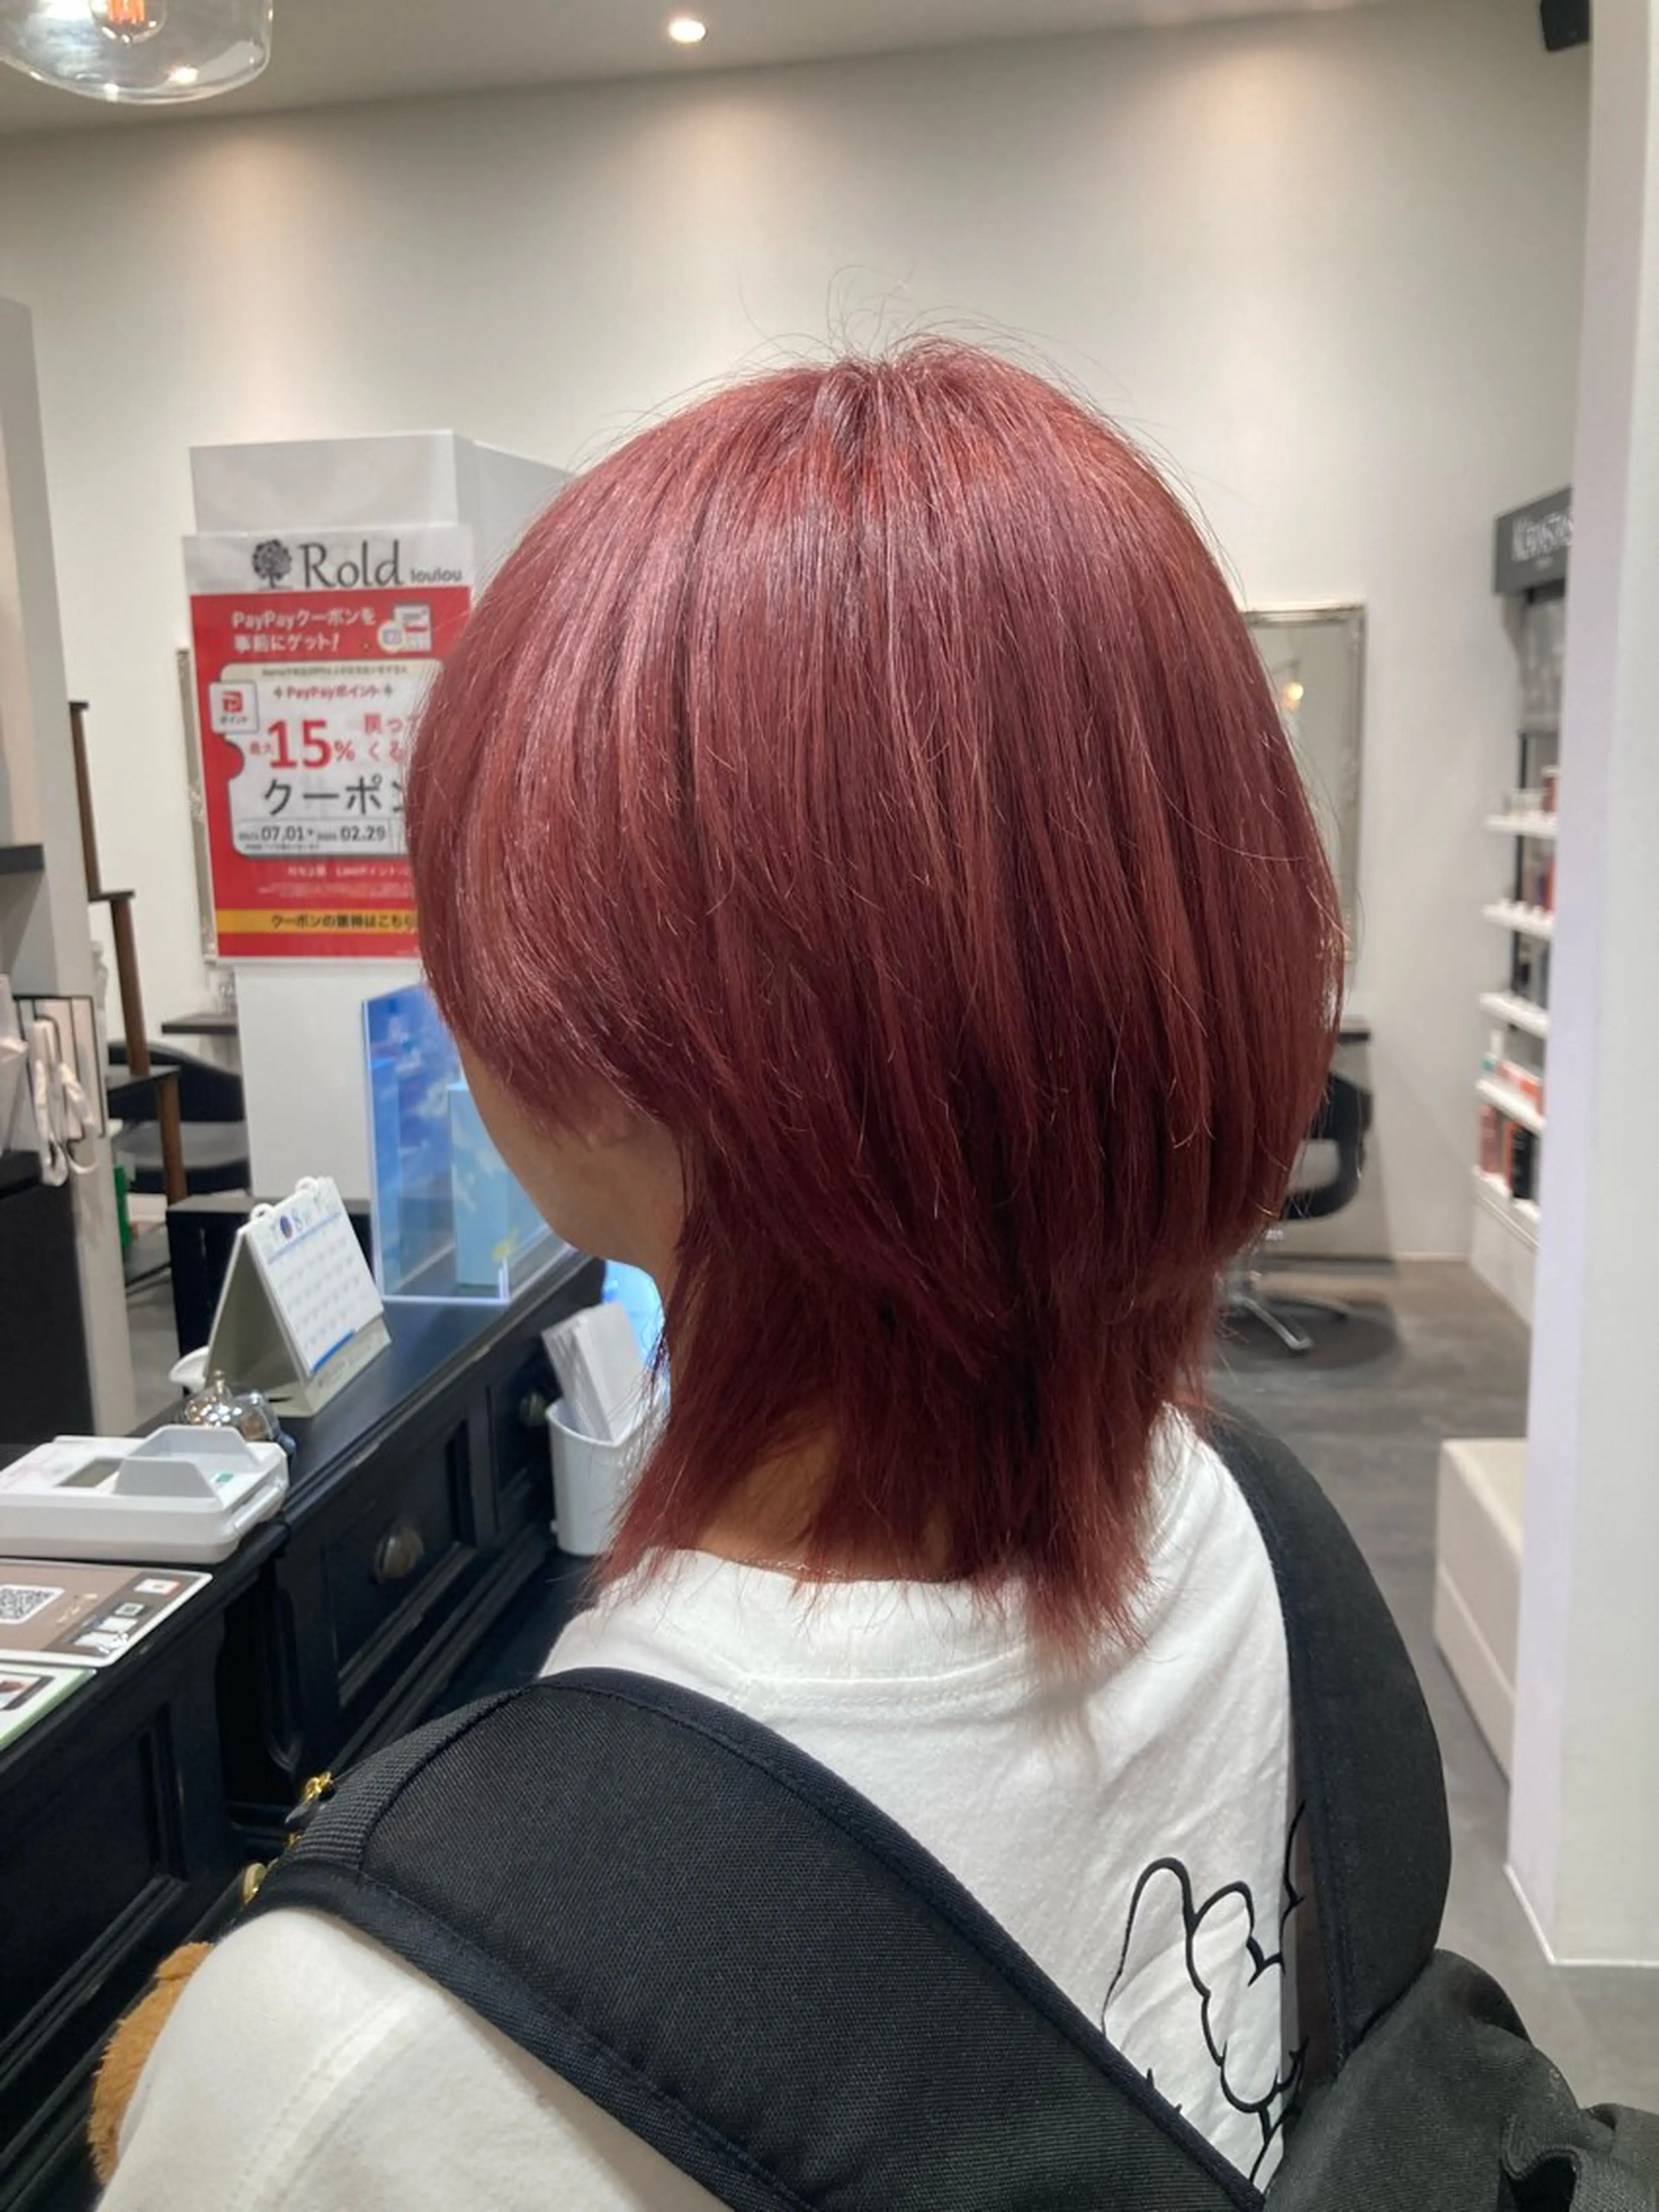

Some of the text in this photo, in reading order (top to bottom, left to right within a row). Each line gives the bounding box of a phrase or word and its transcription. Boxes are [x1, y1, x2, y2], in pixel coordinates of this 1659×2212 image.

[299, 540, 403, 588] Rold
[233, 607, 375, 630] PayPayクーポンを
